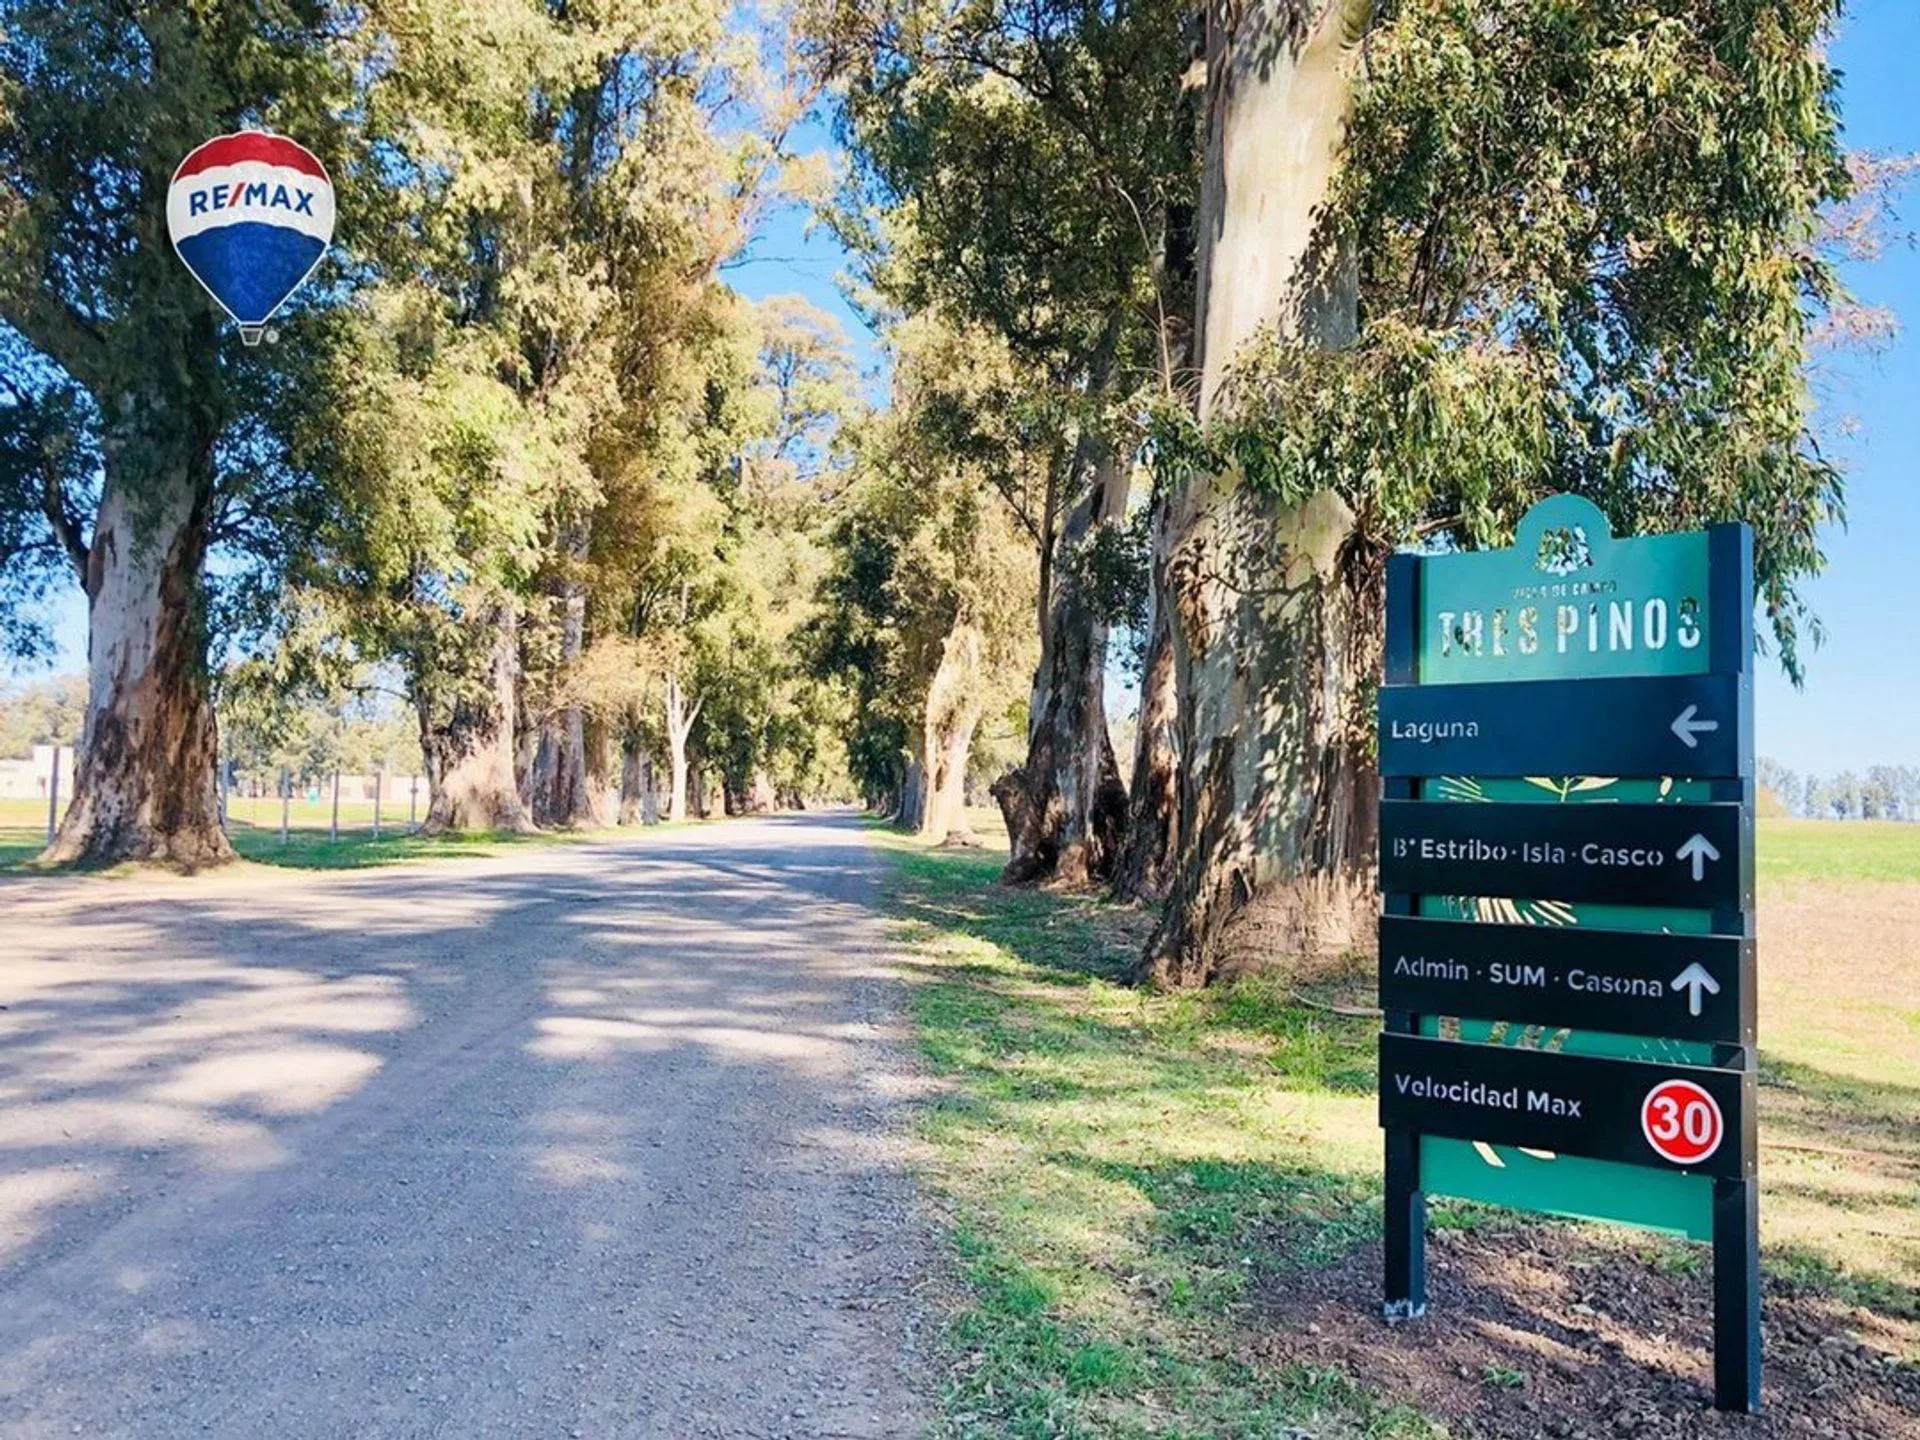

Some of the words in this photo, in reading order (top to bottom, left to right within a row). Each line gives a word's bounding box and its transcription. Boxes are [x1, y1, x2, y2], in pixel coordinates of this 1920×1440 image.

[1438, 606, 1537, 656] TRES
[1557, 597, 1700, 654] PINOS
[1391, 719, 1479, 743] Laguna
[1421, 838, 1508, 861] Estribo
[1523, 842, 1566, 864] Isla
[1581, 843, 1664, 866] Casco
[1394, 955, 1469, 982] Admin
[1489, 963, 1546, 988] SUM
[1567, 969, 1664, 999] Casona
[1394, 1073, 1519, 1111] Velocidad
[1526, 1090, 1582, 1118] Max
[1651, 1096, 1713, 1146] 30
